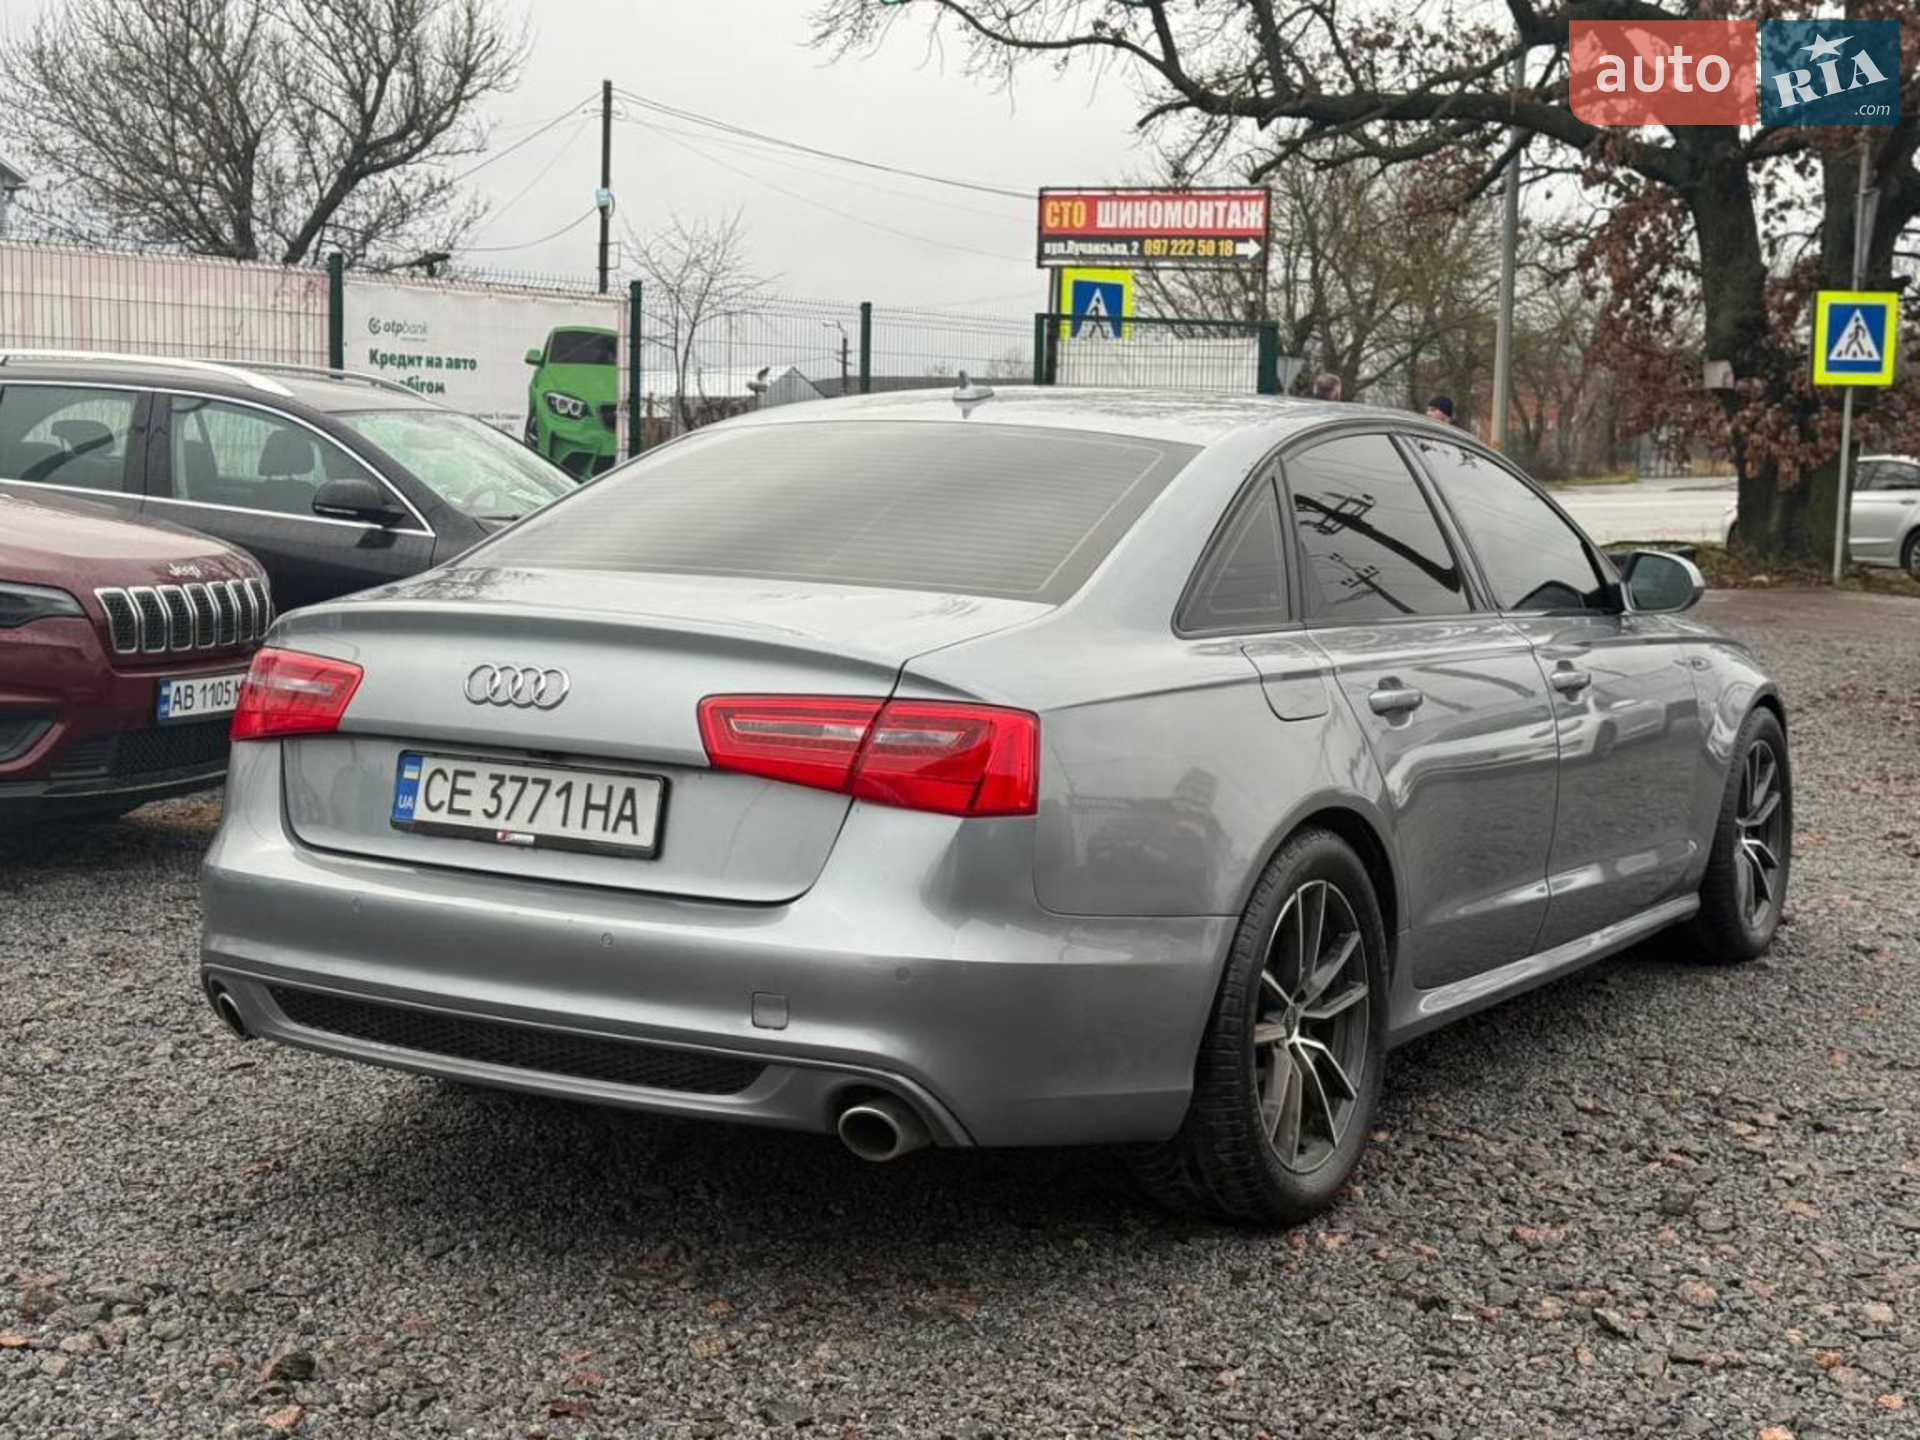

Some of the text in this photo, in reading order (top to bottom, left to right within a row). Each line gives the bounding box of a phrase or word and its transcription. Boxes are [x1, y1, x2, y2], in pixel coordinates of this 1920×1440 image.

[1045, 200, 1265, 230] СТО ШИНОМОНТАЖ
[1131, 240, 1140, 256] 2
[1144, 239, 1169, 256] 097
[1169, 239, 1195, 256] 222
[1197, 239, 1216, 257] 50
[368, 347, 478, 371] Кредит на авто
[390, 375, 445, 394] бігом
[172, 684, 195, 711] AB
[200, 680, 232, 708] 1105
[398, 795, 414, 810] UA
[424, 767, 639, 835] CE 3771 HA
